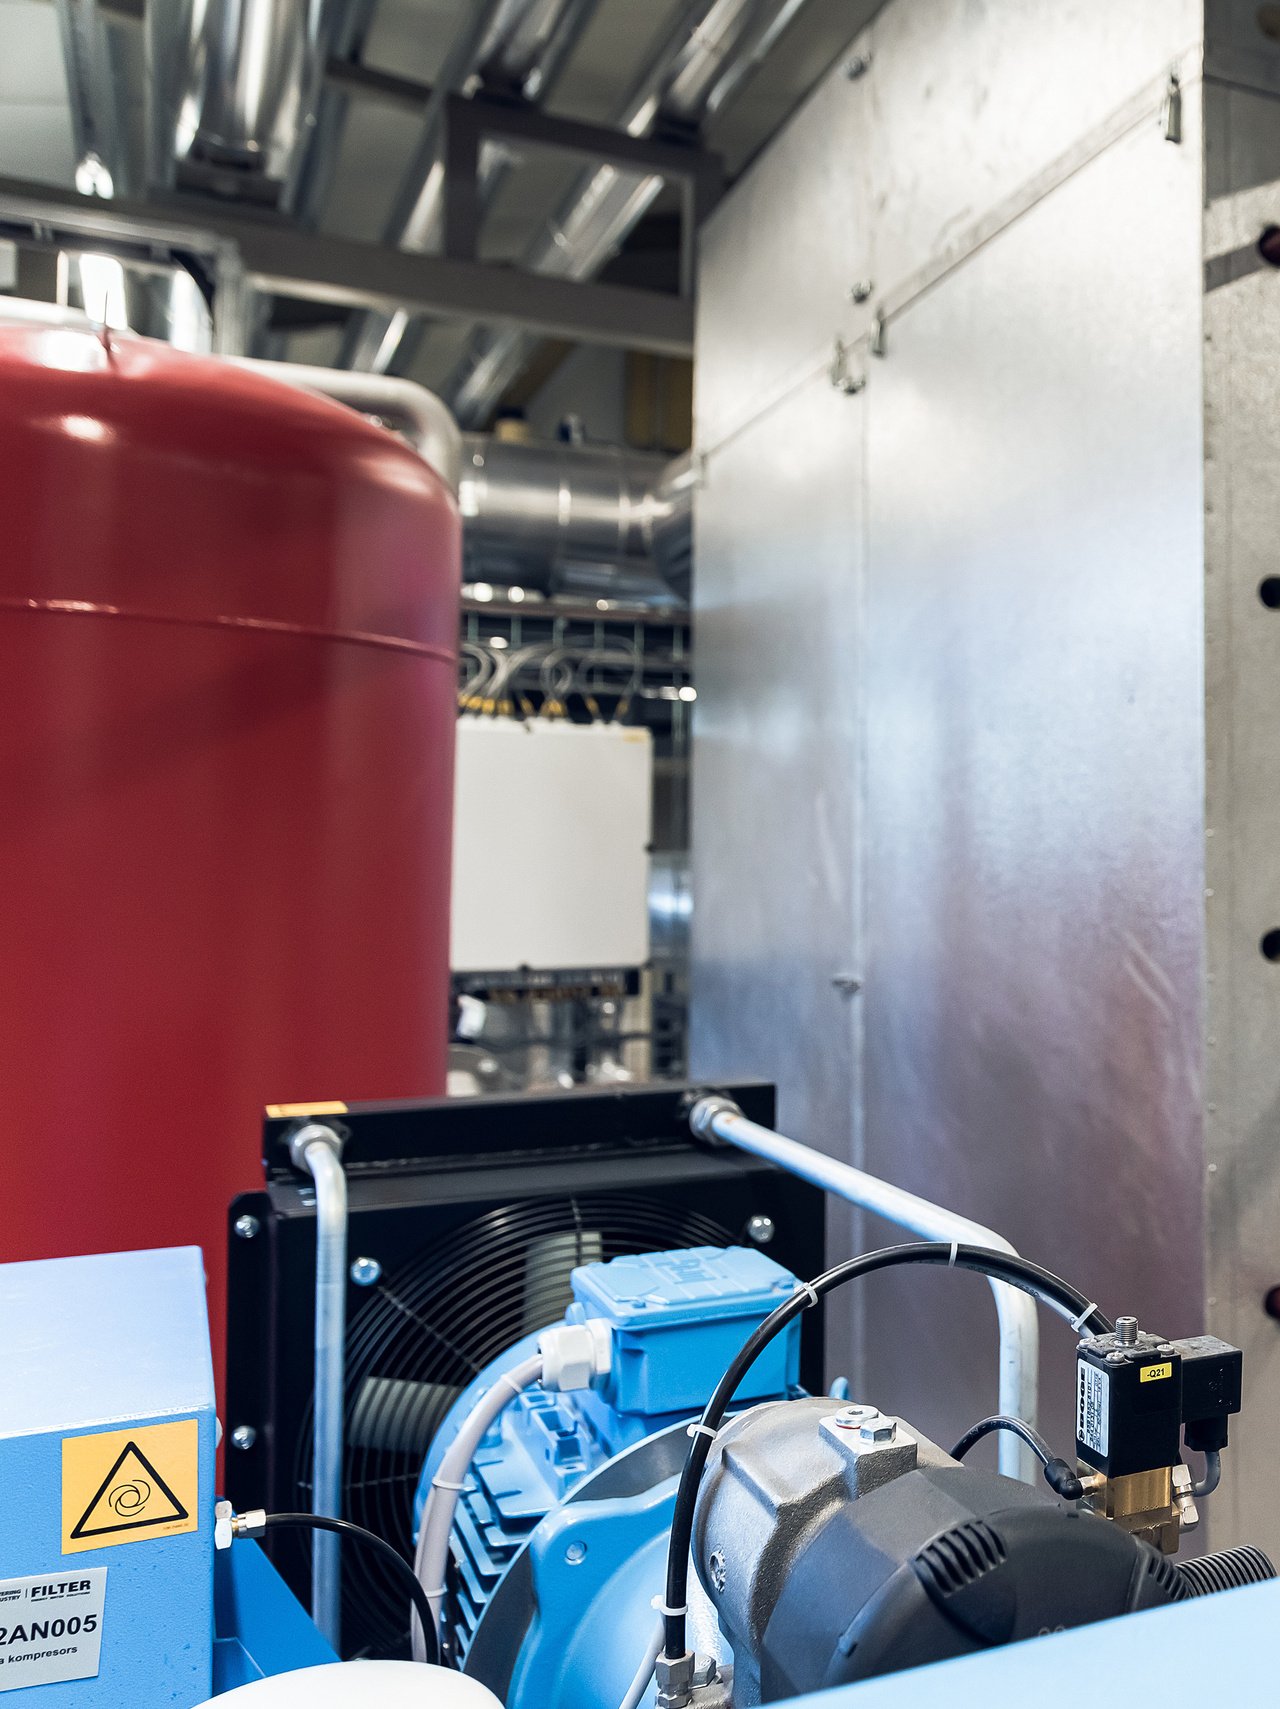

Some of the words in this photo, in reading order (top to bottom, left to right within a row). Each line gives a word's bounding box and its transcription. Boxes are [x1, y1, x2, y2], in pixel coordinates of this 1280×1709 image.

[1146, 1368, 1165, 1378] -Q21
[0, 1589, 21, 1597] ERING
[31, 1580, 91, 1598] FILTER
[0, 1613, 97, 1646] 2AN005
[8, 1646, 78, 1664] kompresors
